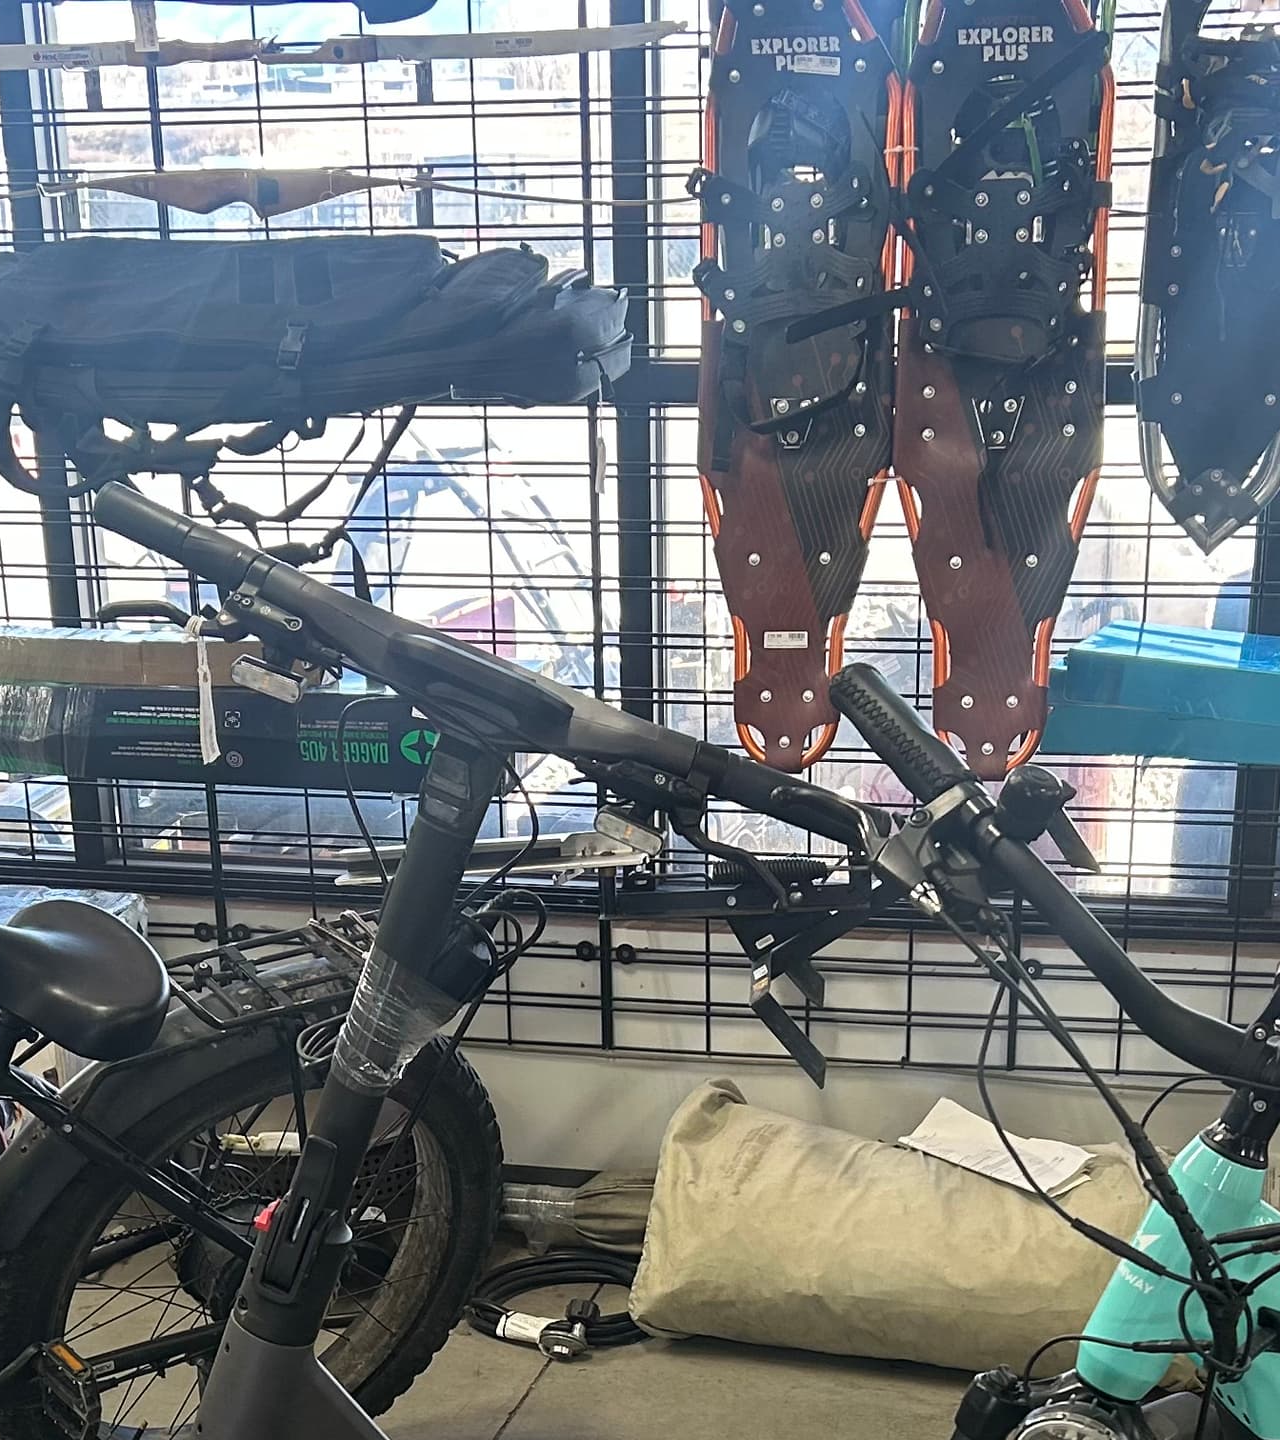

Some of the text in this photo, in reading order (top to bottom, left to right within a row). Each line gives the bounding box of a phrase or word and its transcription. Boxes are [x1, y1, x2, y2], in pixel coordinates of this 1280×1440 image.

[750, 36, 840, 55] EXPLORER
[957, 25, 1054, 46] EXPLORER
[982, 44, 1029, 62] PLUS
[299, 740, 389, 765] DAGGER 405
